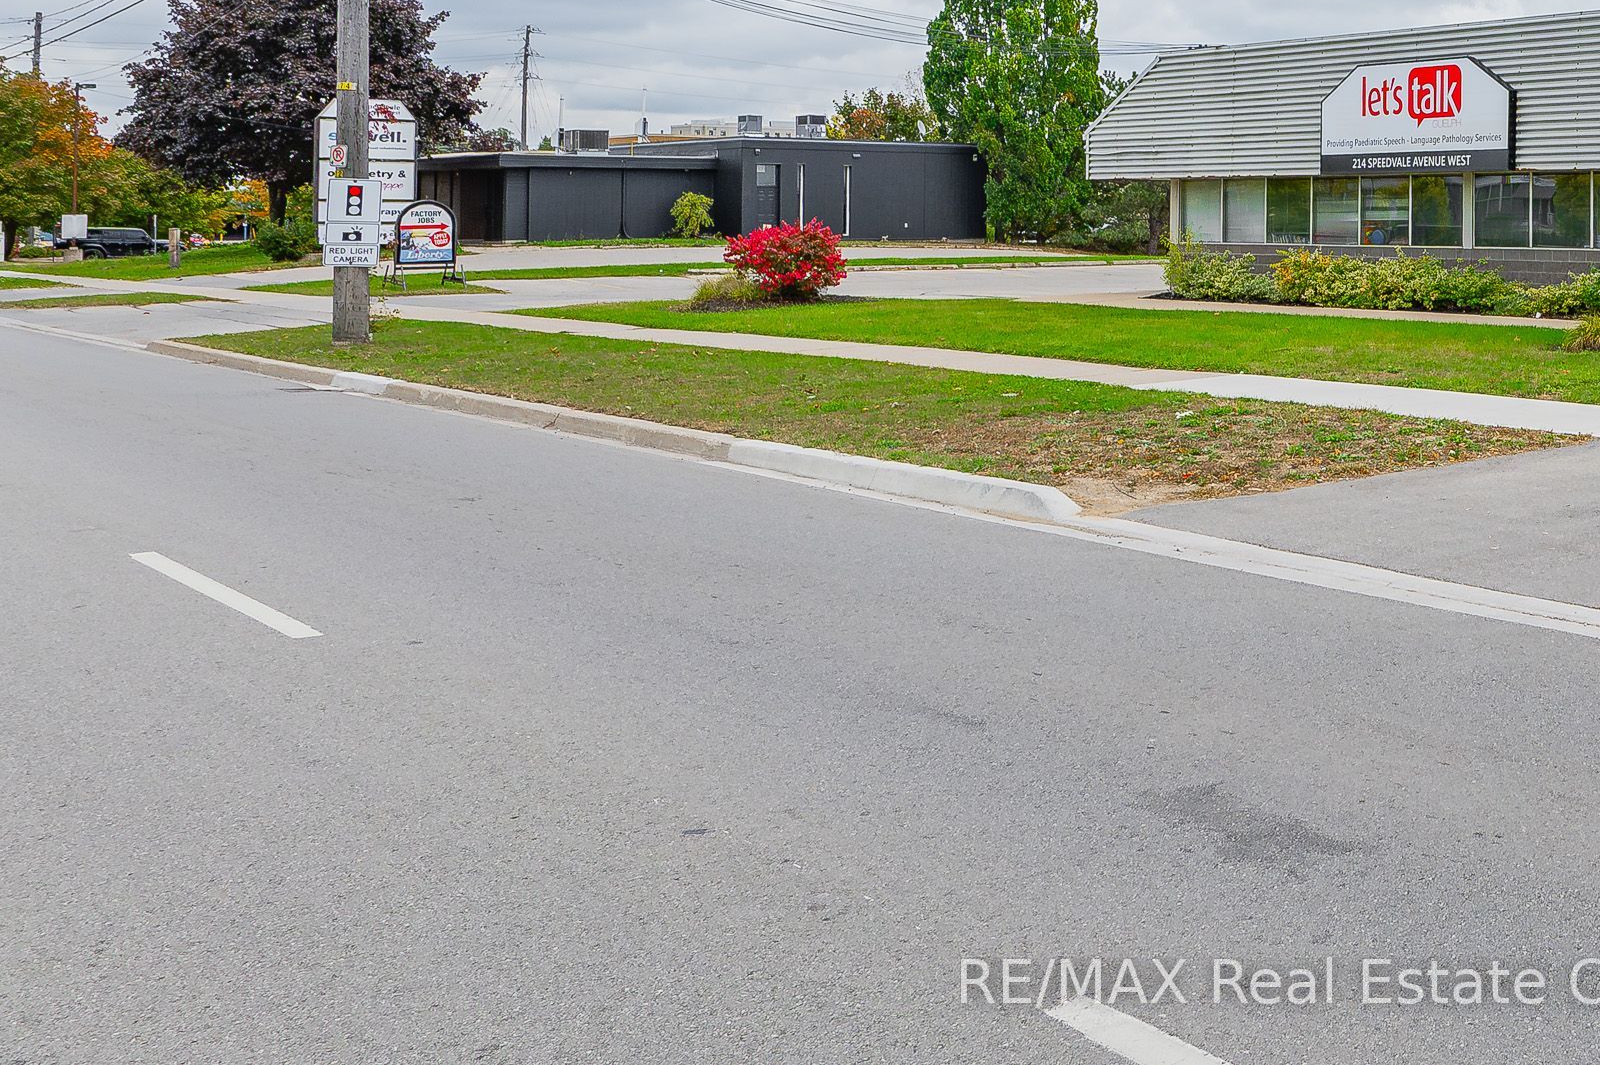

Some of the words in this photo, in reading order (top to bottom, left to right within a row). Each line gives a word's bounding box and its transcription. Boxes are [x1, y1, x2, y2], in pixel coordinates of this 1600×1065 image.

[1360, 76, 1404, 117] let's
[1411, 69, 1460, 118] talk
[1431, 118, 1463, 129] GUELPH
[1326, 138, 1354, 149] Providing
[1354, 137, 1383, 147] Paediatric
[1383, 136, 1406, 147] Speech
[1410, 135, 1441, 146] Language
[1441, 134, 1474, 145] Pathology
[1474, 132, 1502, 142] Services
[1352, 157, 1366, 169] 214
[1367, 156, 1411, 168] SPEEDVALE
[1412, 155, 1446, 167] AVENUE
[1446, 154, 1472, 166] WEST
[398, 169, 407, 178] &
[350, 247, 374, 255] LIGHT
[406, 249, 443, 259] Liberty
